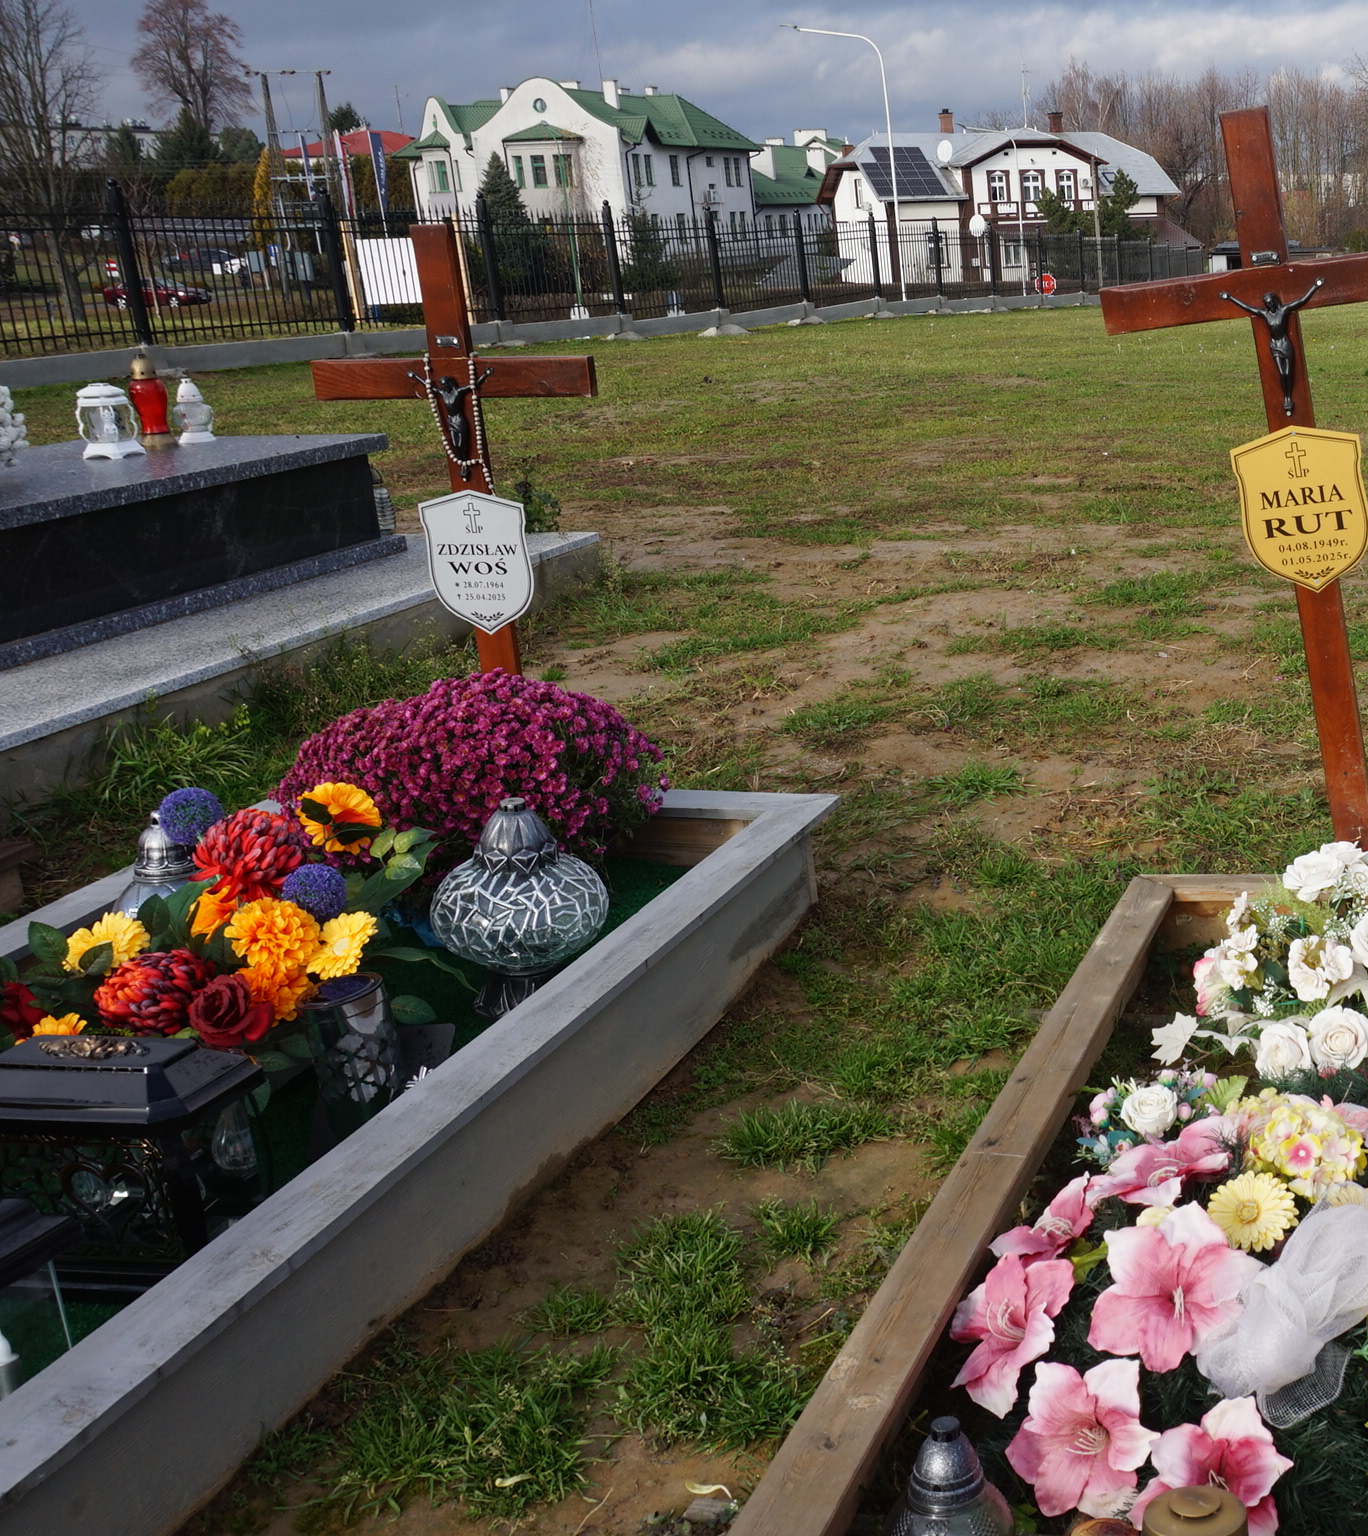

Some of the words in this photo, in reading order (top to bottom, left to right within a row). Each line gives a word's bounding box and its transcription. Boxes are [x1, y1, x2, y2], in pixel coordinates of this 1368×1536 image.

[1259, 483, 1346, 511] MARIA
[1261, 509, 1353, 540] RUT
[436, 543, 518, 556] ZDZISŁAW
[1278, 538, 1349, 554] 04.08.1949r.
[447, 558, 508, 575] WOŚ
[1281, 551, 1352, 567] 01.05.2025r.
[463, 581, 505, 589] 28.07.1964
[465, 593, 507, 601] 25.04.2025
